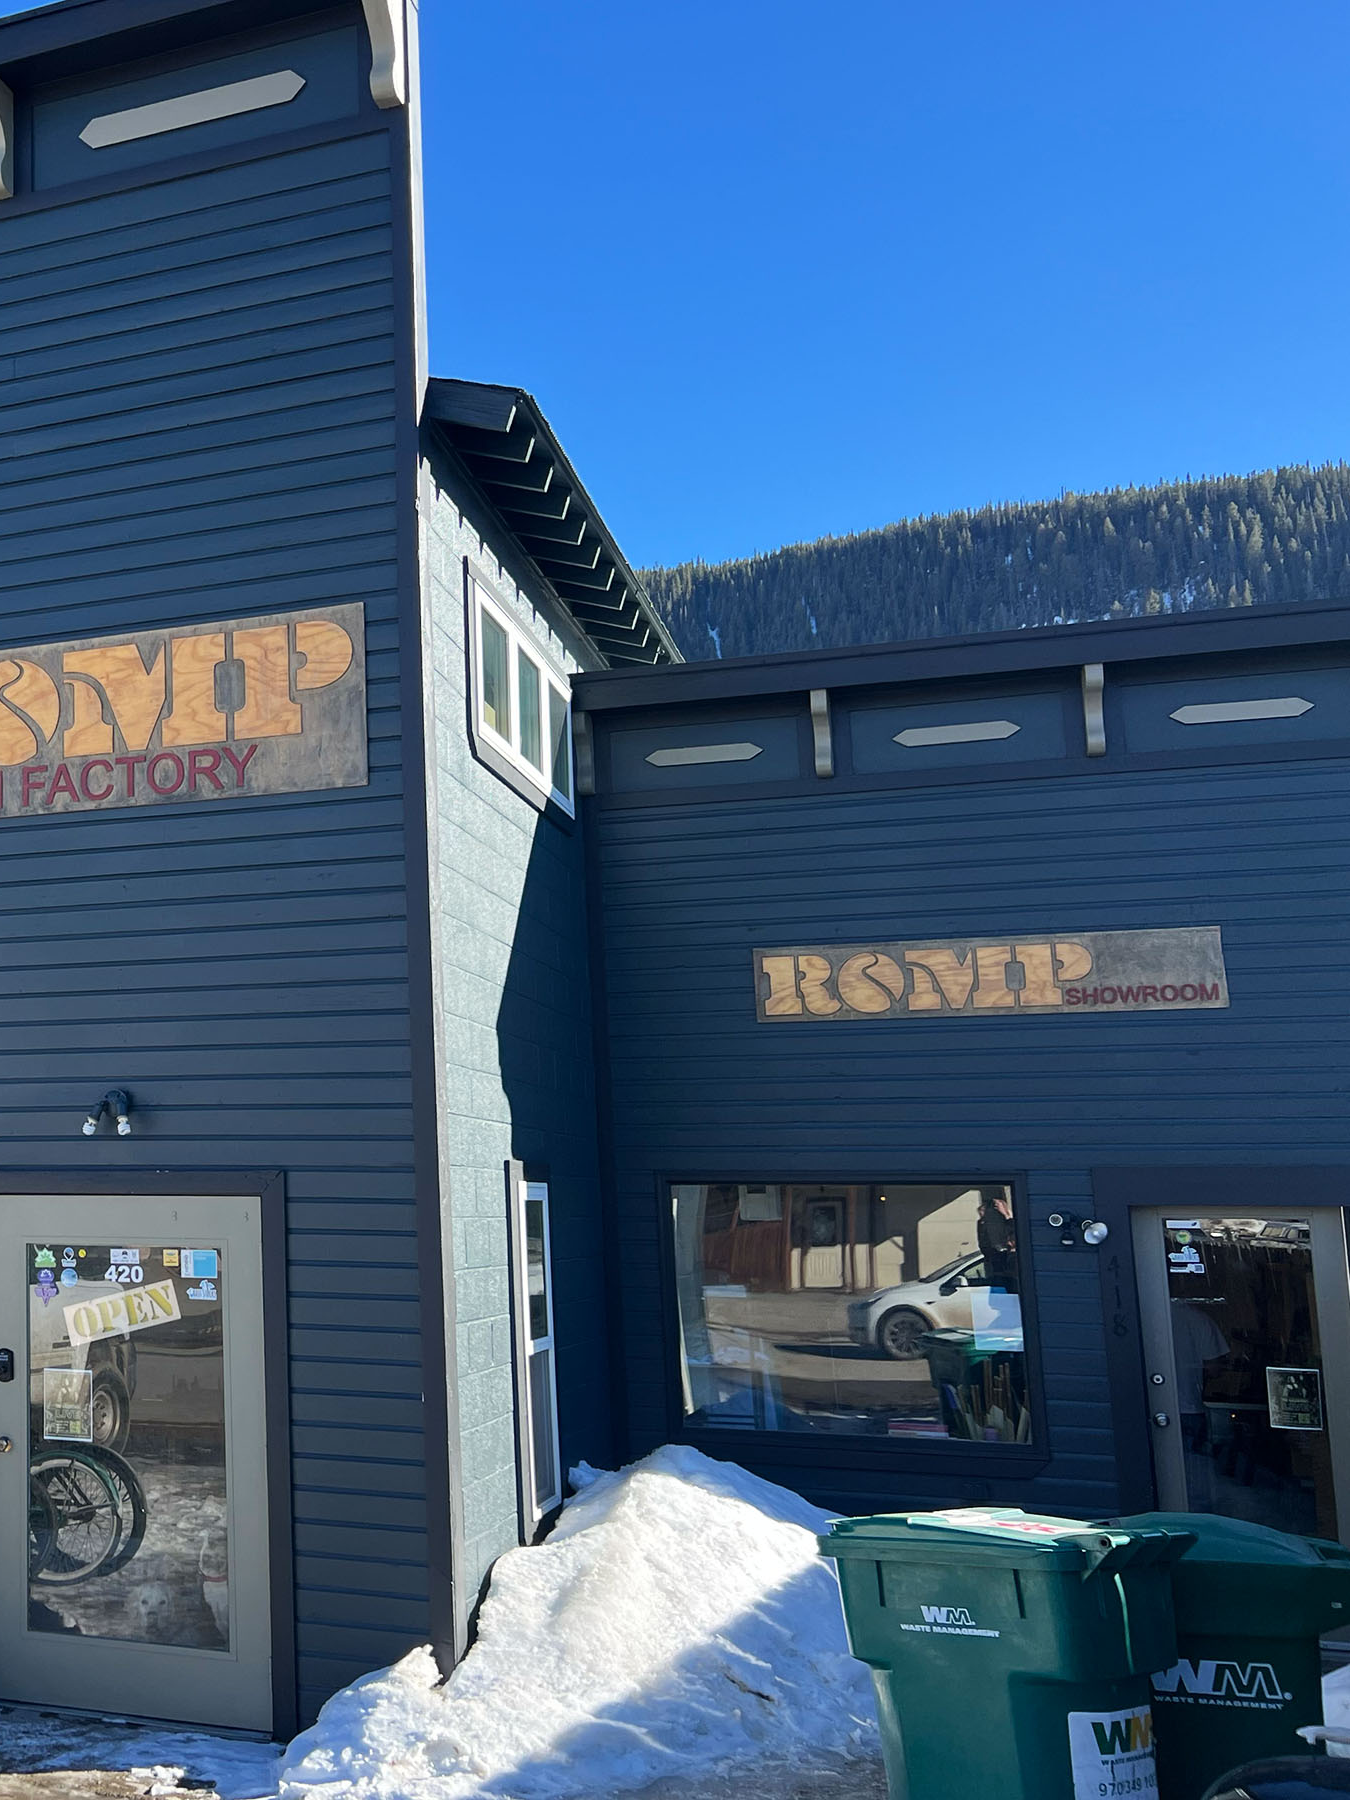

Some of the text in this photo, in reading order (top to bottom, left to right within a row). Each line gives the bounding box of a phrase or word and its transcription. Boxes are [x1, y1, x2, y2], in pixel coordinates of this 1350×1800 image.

[22, 744, 259, 807] FACTORY
[762, 943, 1093, 1016] ROMP
[1065, 983, 1220, 1006] SHOWROOM
[104, 1265, 144, 1283] 420
[73, 1284, 174, 1338] OPEN
[920, 1605, 972, 1625] WM
[900, 1623, 931, 1633] WASTE
[1151, 1659, 1284, 1700] WM
[1154, 1695, 1284, 1710] WASTE MANAGEMENT
